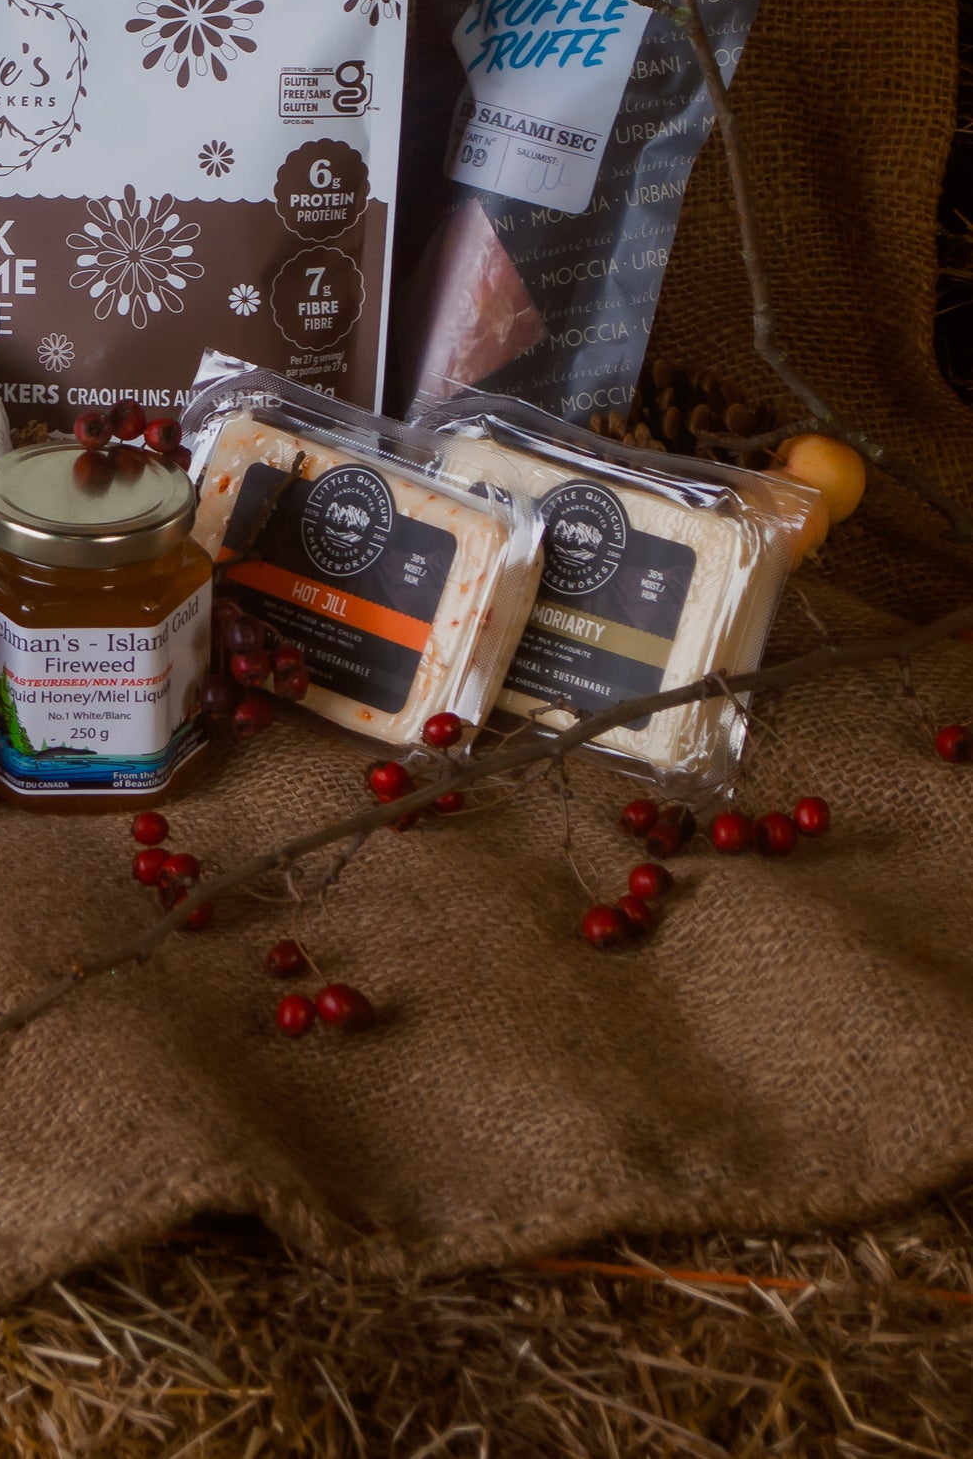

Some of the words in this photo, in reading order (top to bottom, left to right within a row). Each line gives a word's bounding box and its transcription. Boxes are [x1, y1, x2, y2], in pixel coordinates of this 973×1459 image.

[467, 28, 621, 74] TRUFFE
[283, 77, 319, 87] GLUTEN
[283, 89, 331, 101] FREE/SANS
[283, 102, 319, 112] GLUTEN
[477, 108, 556, 142] SALAMI
[556, 129, 597, 152] SEC
[615, 117, 688, 146] URBANI
[460, 144, 488, 168] 09
[290, 191, 355, 209] PROTEIN
[625, 179, 688, 207] URBANI
[296, 206, 348, 222] PROTÉINE
[542, 257, 620, 290] MOCCIA
[297, 300, 340, 316] FIBRE
[304, 317, 333, 331] FIBRE
[550, 321, 629, 351] MOCCIA
[290, 355, 303, 365] Per
[303, 354, 313, 364] 27
[331, 362, 341, 371] 27
[560, 384, 637, 413] MOCCIA
[315, 474, 350, 500] LITTLE
[356, 475, 388, 523] QUALICUM
[560, 505, 608, 529] HANDCRAFTED
[585, 491, 622, 540] QUALICUM
[307, 527, 374, 571] CHEESEWORKS
[292, 581, 320, 605] HOT
[321, 592, 347, 617] JILL
[107, 627, 169, 652] Island
[172, 595, 199, 634] Gold
[531, 603, 606, 642] MORIARTY
[45, 656, 136, 673] Fireweed
[315, 650, 371, 678] SUSTAINABLE
[552, 669, 612, 696] SUSTAINABLE
[41, 690, 130, 706] Honey/Miel
[73, 711, 131, 721] White/Blanc
[71, 728, 97, 739] 250
[100, 729, 109, 741] g
[37, 781, 70, 789] CANADA
[113, 771, 138, 780] From
[139, 771, 156, 779] the
[113, 779, 123, 787] of
